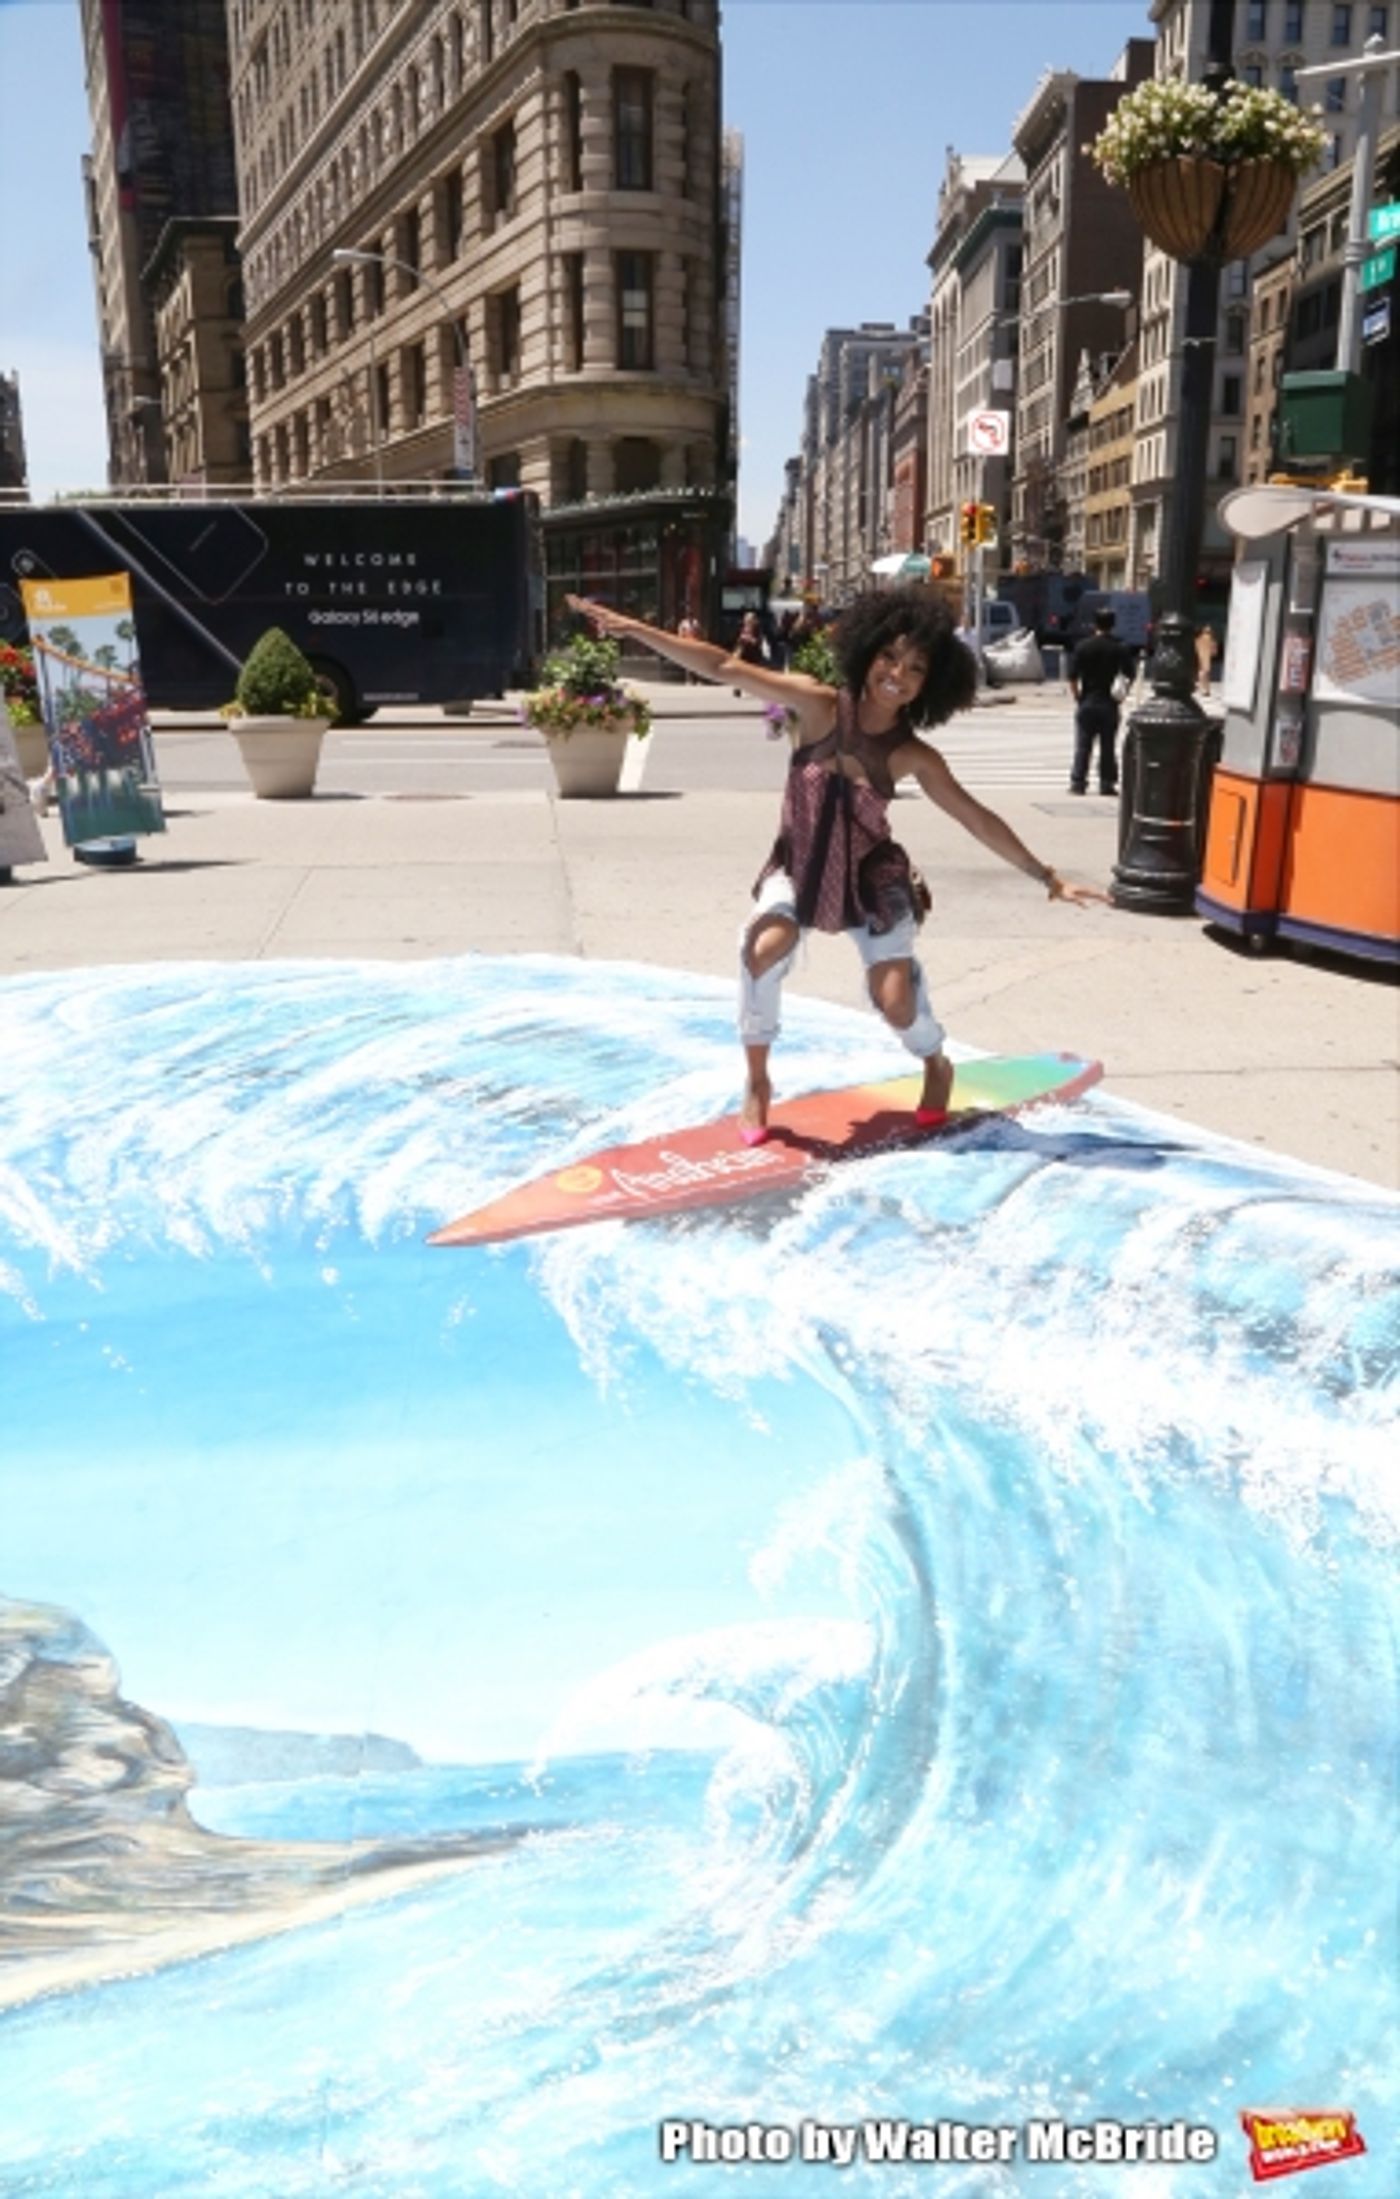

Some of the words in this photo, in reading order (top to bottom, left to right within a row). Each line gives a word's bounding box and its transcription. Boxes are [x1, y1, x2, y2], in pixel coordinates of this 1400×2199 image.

[303, 552, 417, 567] WELCOME
[285, 581, 310, 596] TO
[328, 580, 366, 596] THE
[387, 577, 442, 596] EDGE
[307, 607, 361, 628] Galaxy
[380, 607, 420, 629] edge
